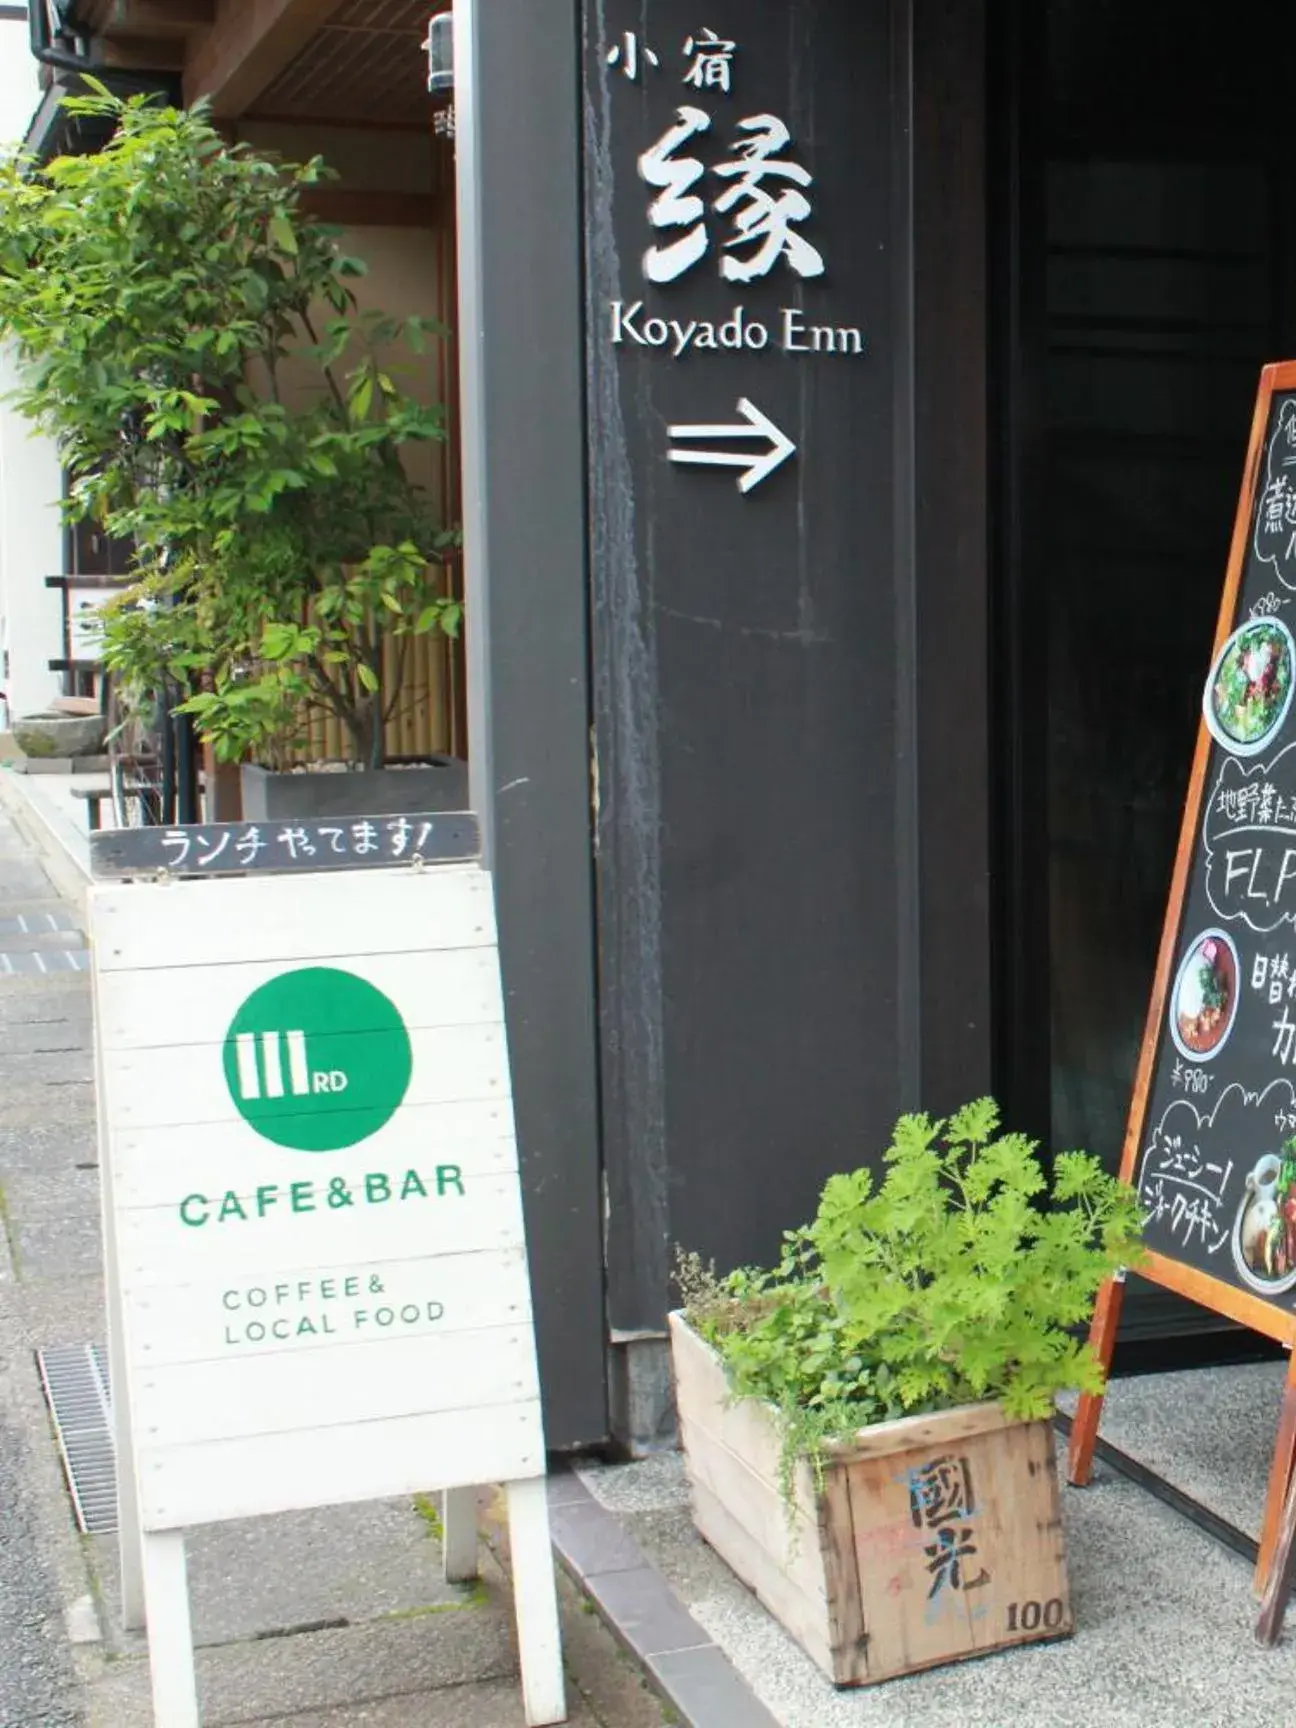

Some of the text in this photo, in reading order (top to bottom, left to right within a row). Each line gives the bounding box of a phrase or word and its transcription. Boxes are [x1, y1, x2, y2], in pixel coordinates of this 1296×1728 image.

[607, 27, 737, 92] 小宿
[638, 106, 826, 284] 縁
[609, 301, 864, 357] Koyado Enn
[179, 1165, 467, 1227] CAFE&BAR
[222, 1273, 386, 1311] COFFEE&
[225, 1299, 446, 1345] LOCAL FOOD
[1006, 1597, 1065, 1633] 100
